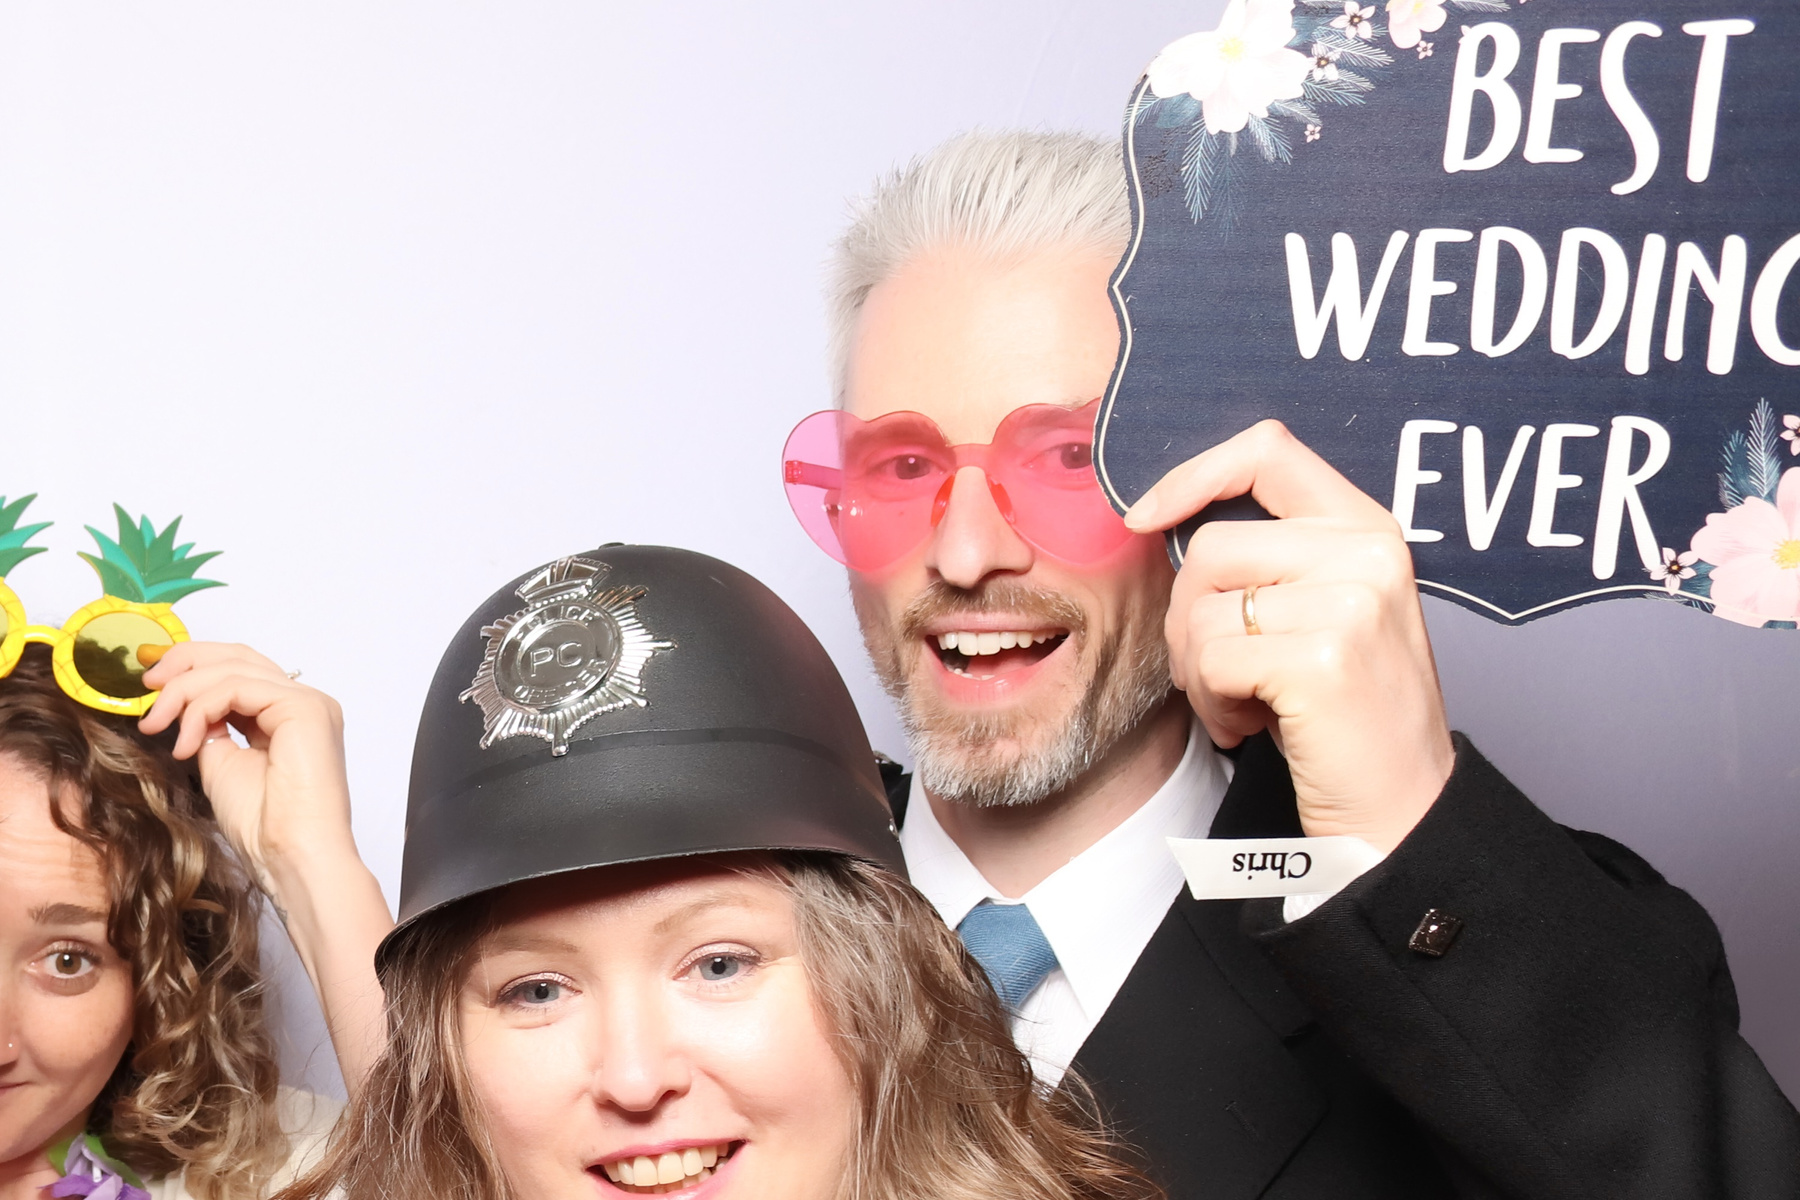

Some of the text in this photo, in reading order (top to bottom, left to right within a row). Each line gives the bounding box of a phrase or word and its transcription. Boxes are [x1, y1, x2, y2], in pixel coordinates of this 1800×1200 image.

[1443, 19, 1755, 196] BEST
[1391, 414, 1671, 580] EVER
[530, 641, 583, 678] PC
[1232, 851, 1312, 881] Chris
